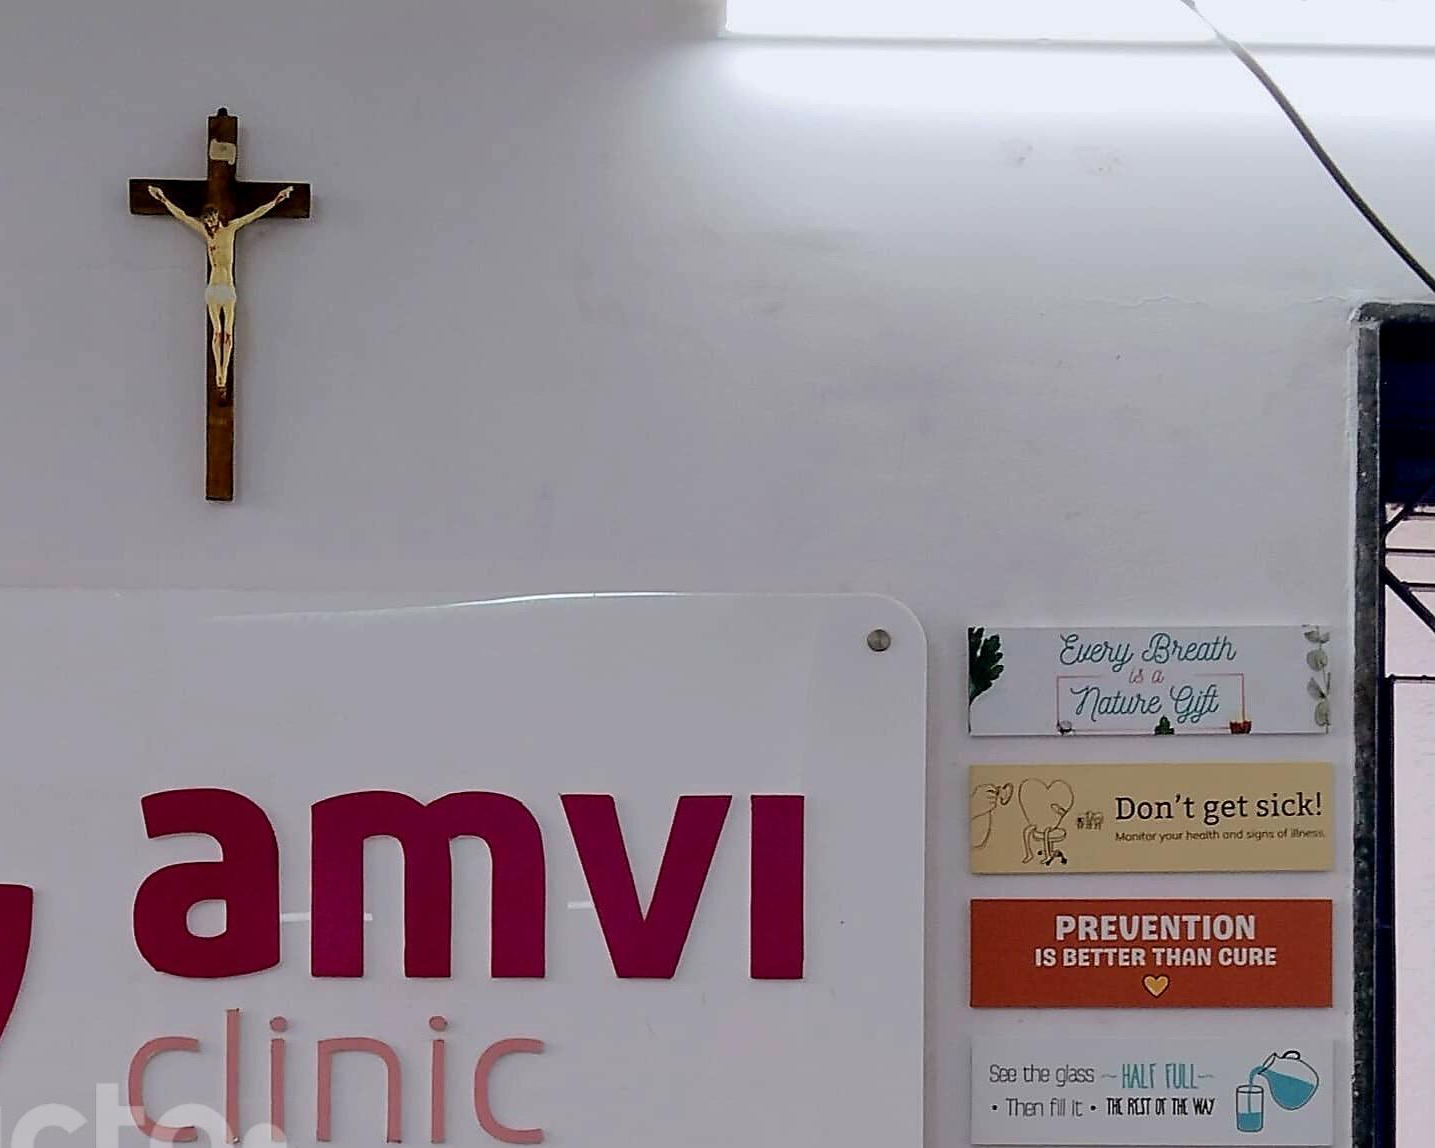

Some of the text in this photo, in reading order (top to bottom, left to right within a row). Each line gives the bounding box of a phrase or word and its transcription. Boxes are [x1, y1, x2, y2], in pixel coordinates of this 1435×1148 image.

[1059, 632, 1236, 672] Every Breath
[1128, 668, 1165, 685] is a
[1070, 684, 1220, 723] Nature Gift
[1114, 791, 1323, 827] Don't get sick!
[1114, 830, 1157, 843] Monitor
[1158, 832, 1183, 845] your
[1185, 829, 1220, 842] health
[1221, 828, 1244, 841] and
[1246, 829, 1275, 842] signs
[1276, 827, 1289, 839] of
[1055, 914, 1256, 942] PREVENTION
[1035, 947, 1278, 968] IS BETTER THAN CURE
[127, 1009, 546, 1146] clinic
[989, 1063, 1199, 1089] See the glass HALF FULL
[1006, 1097, 1217, 1117] Then fill it THE REST OF THE WAY
